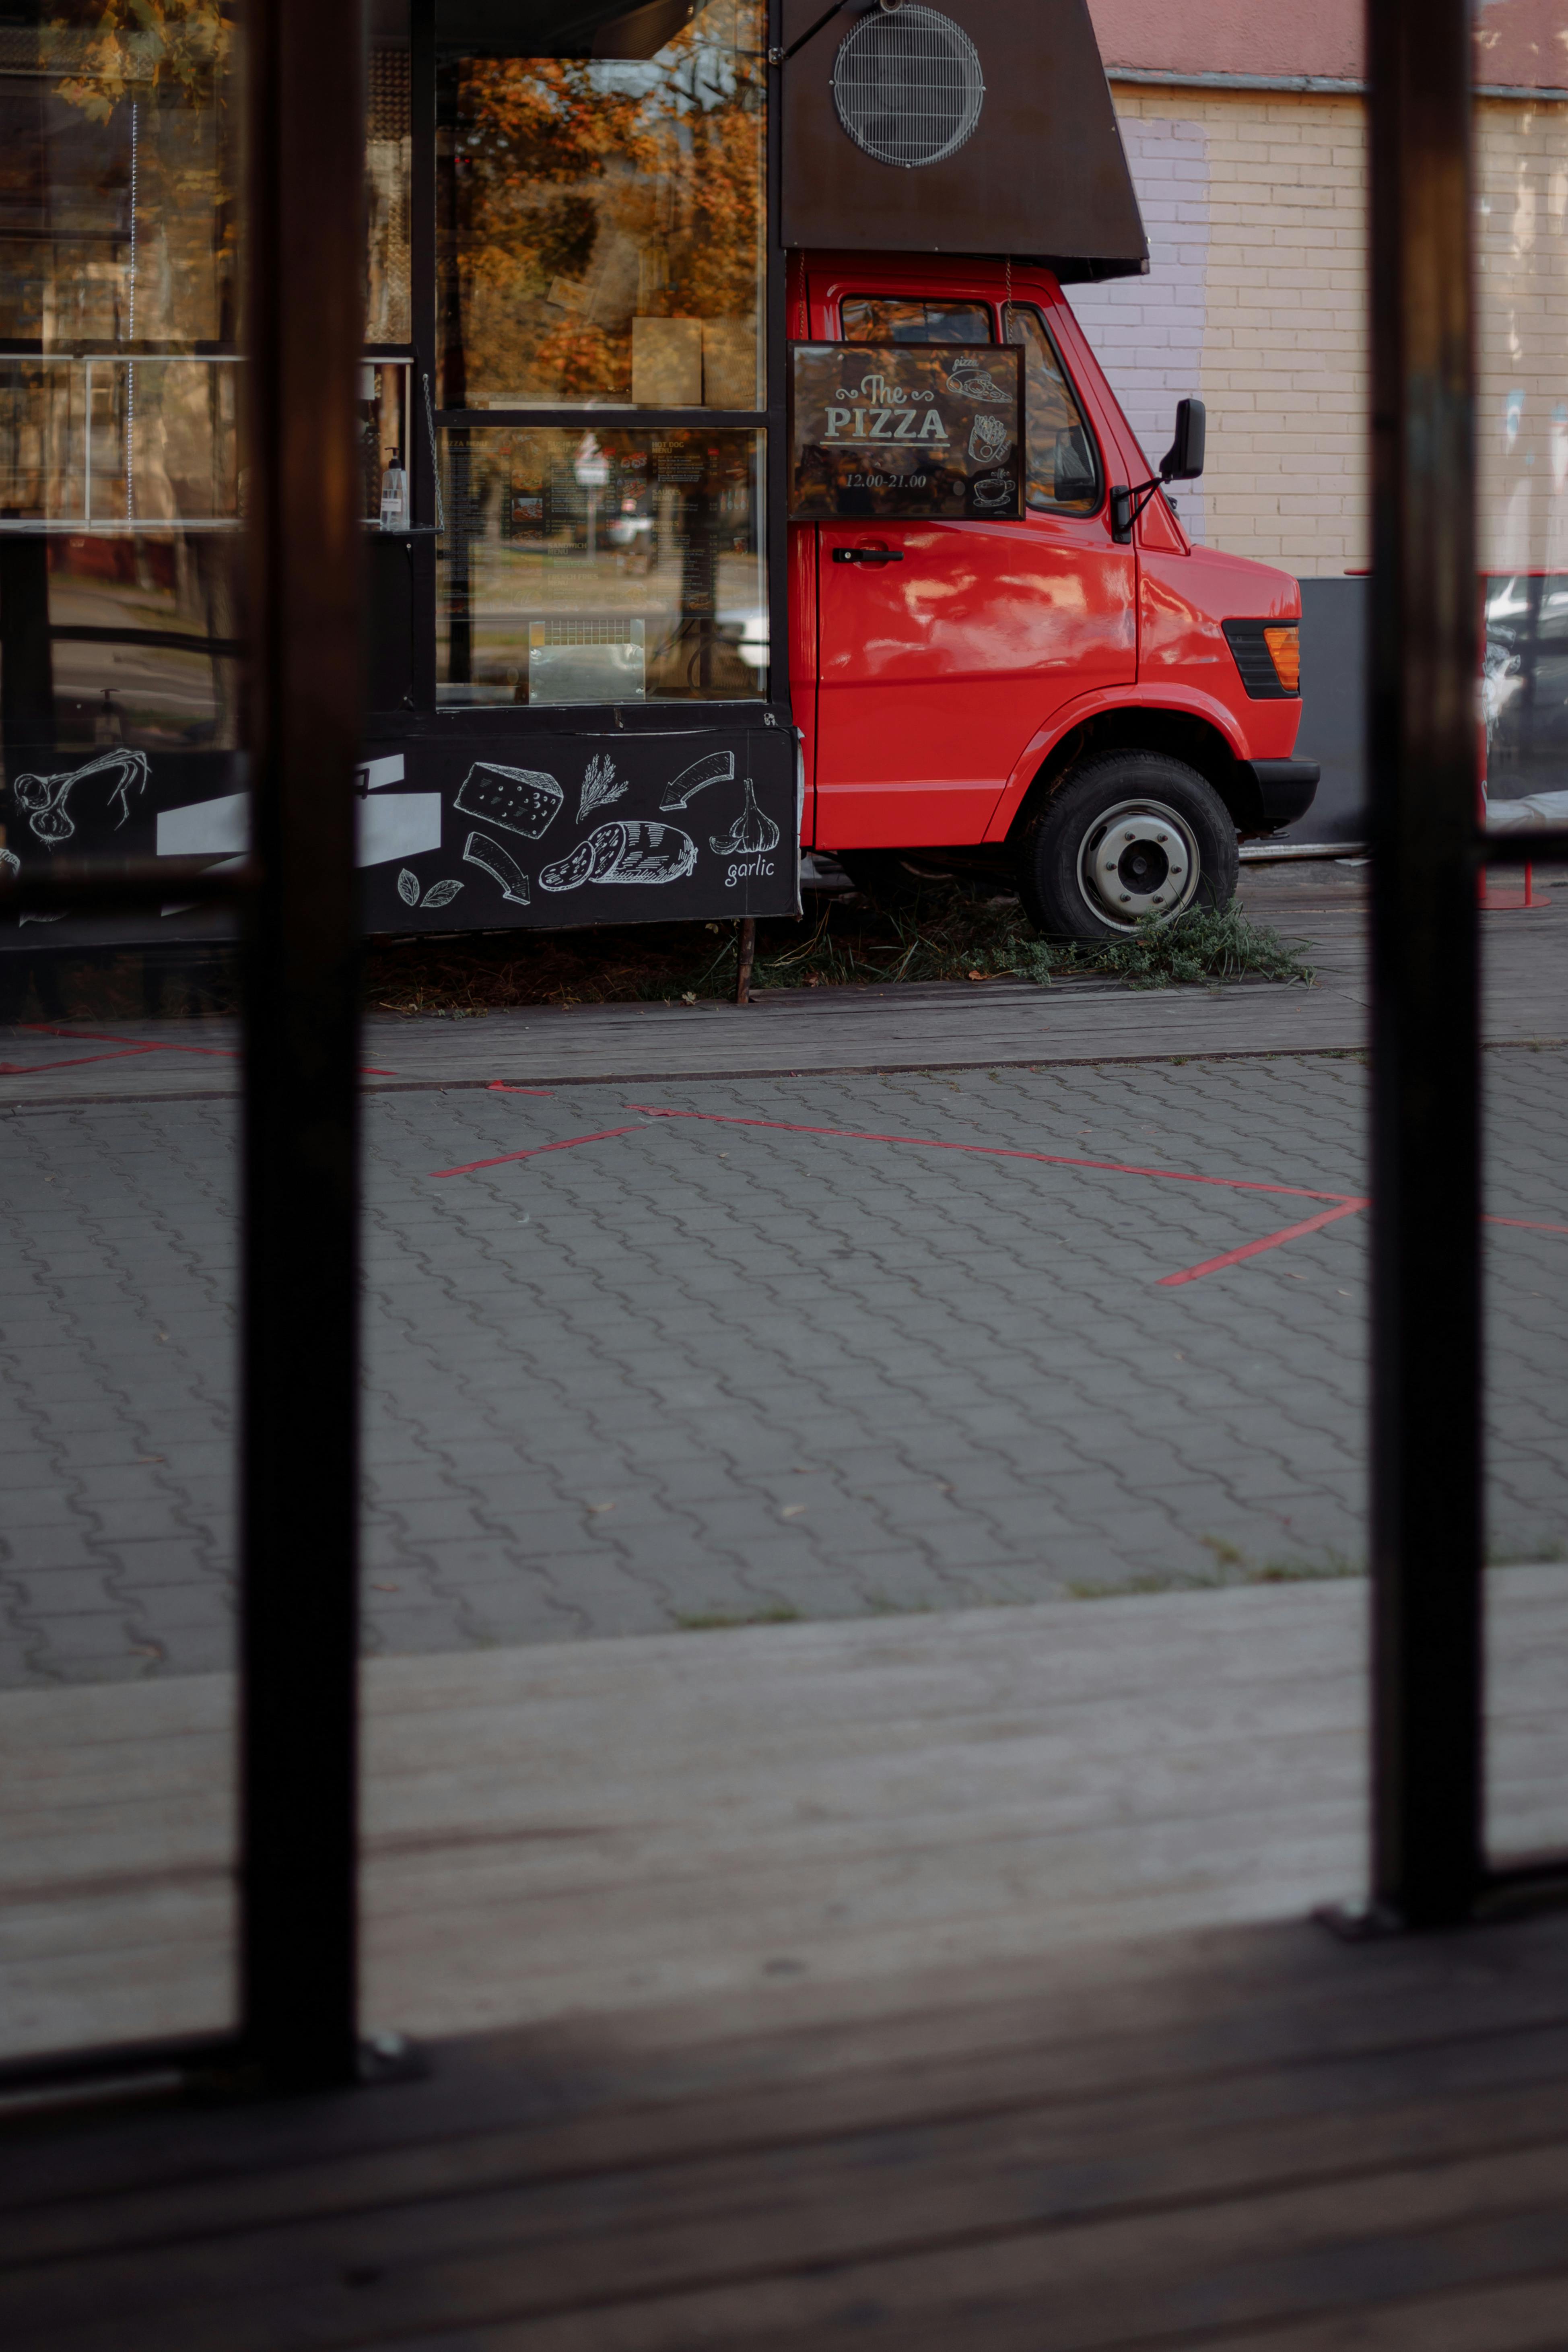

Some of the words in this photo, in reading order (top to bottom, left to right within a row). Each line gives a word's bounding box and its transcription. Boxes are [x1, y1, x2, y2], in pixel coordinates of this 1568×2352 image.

[952, 356, 979, 372] pizza
[860, 375, 907, 404] The
[824, 407, 949, 439] PIZZA
[846, 474, 926, 487] 12.00-21.00
[991, 468, 1010, 479] coffee
[725, 853, 775, 887] garlic
